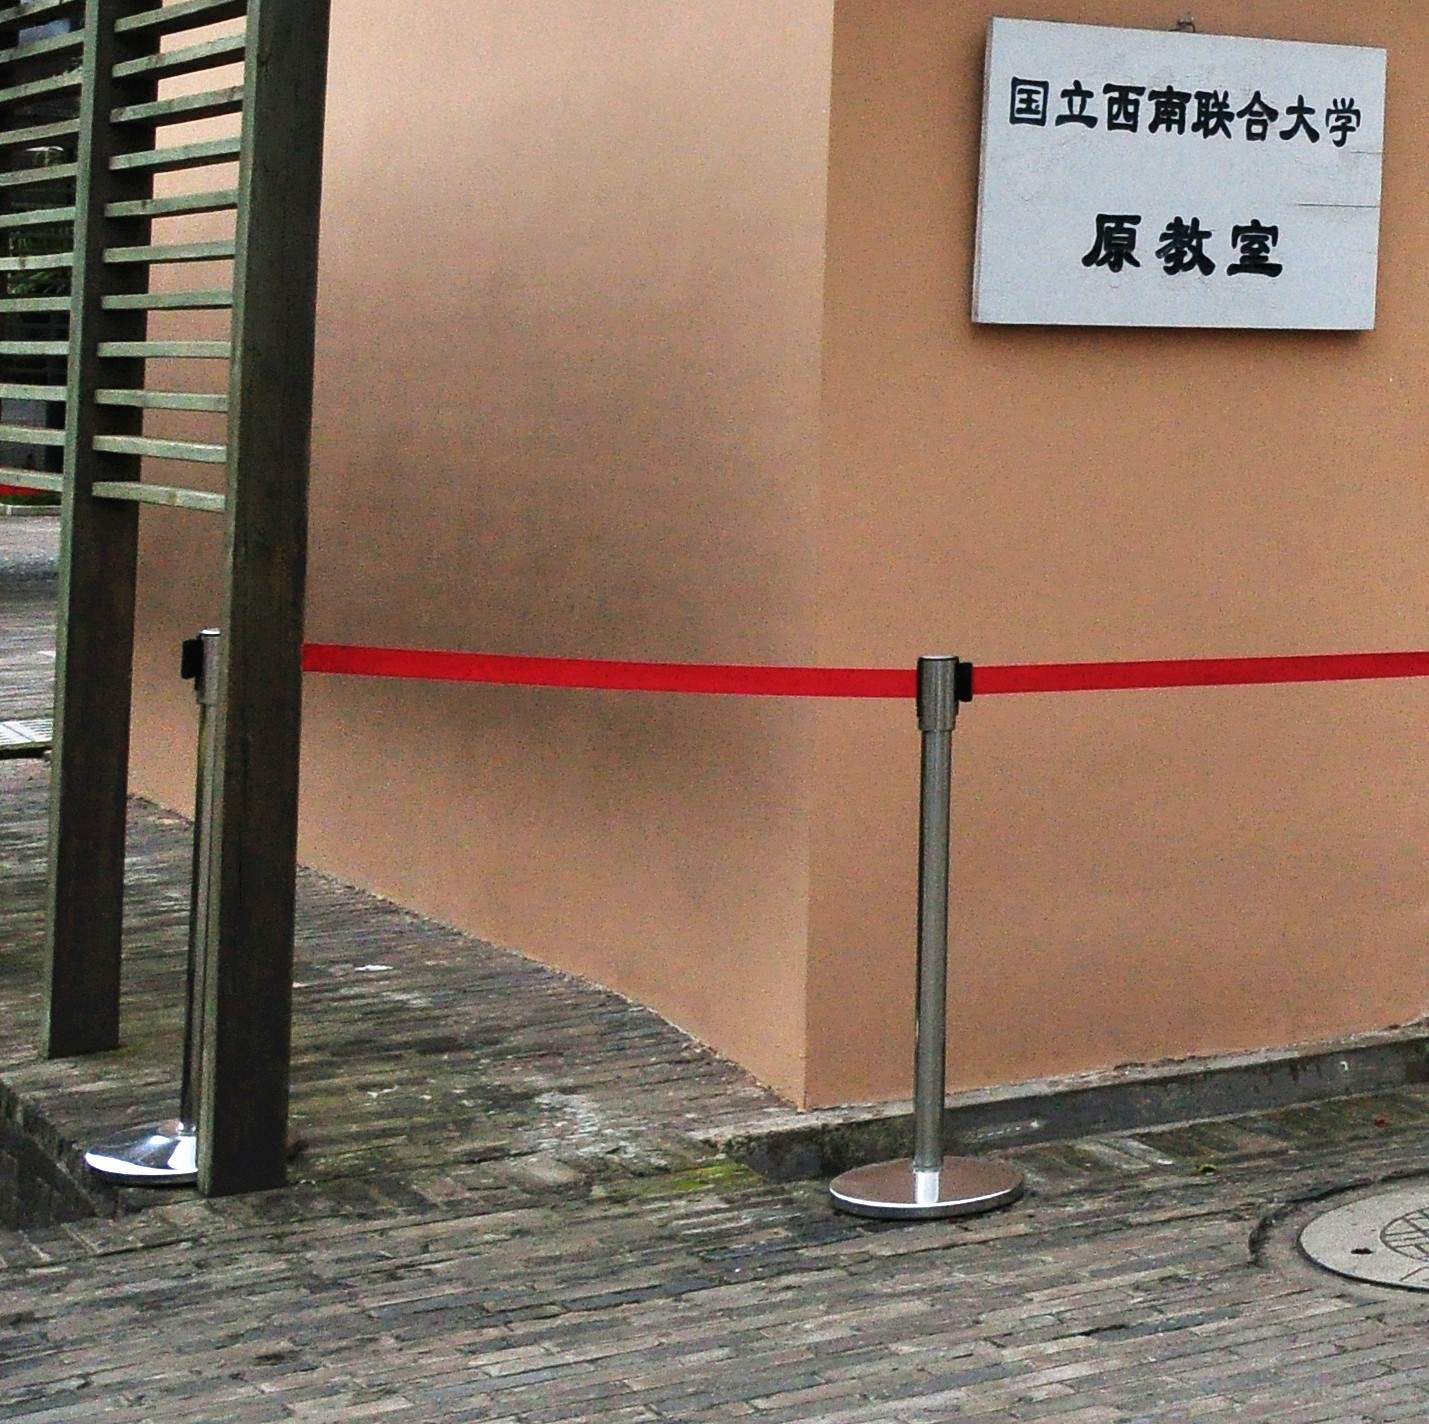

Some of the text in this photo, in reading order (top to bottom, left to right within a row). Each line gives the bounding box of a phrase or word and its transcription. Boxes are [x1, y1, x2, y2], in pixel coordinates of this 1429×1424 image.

[1009, 76, 1362, 147] 国立西南联合大学
[1081, 213, 1284, 278] 原教室
